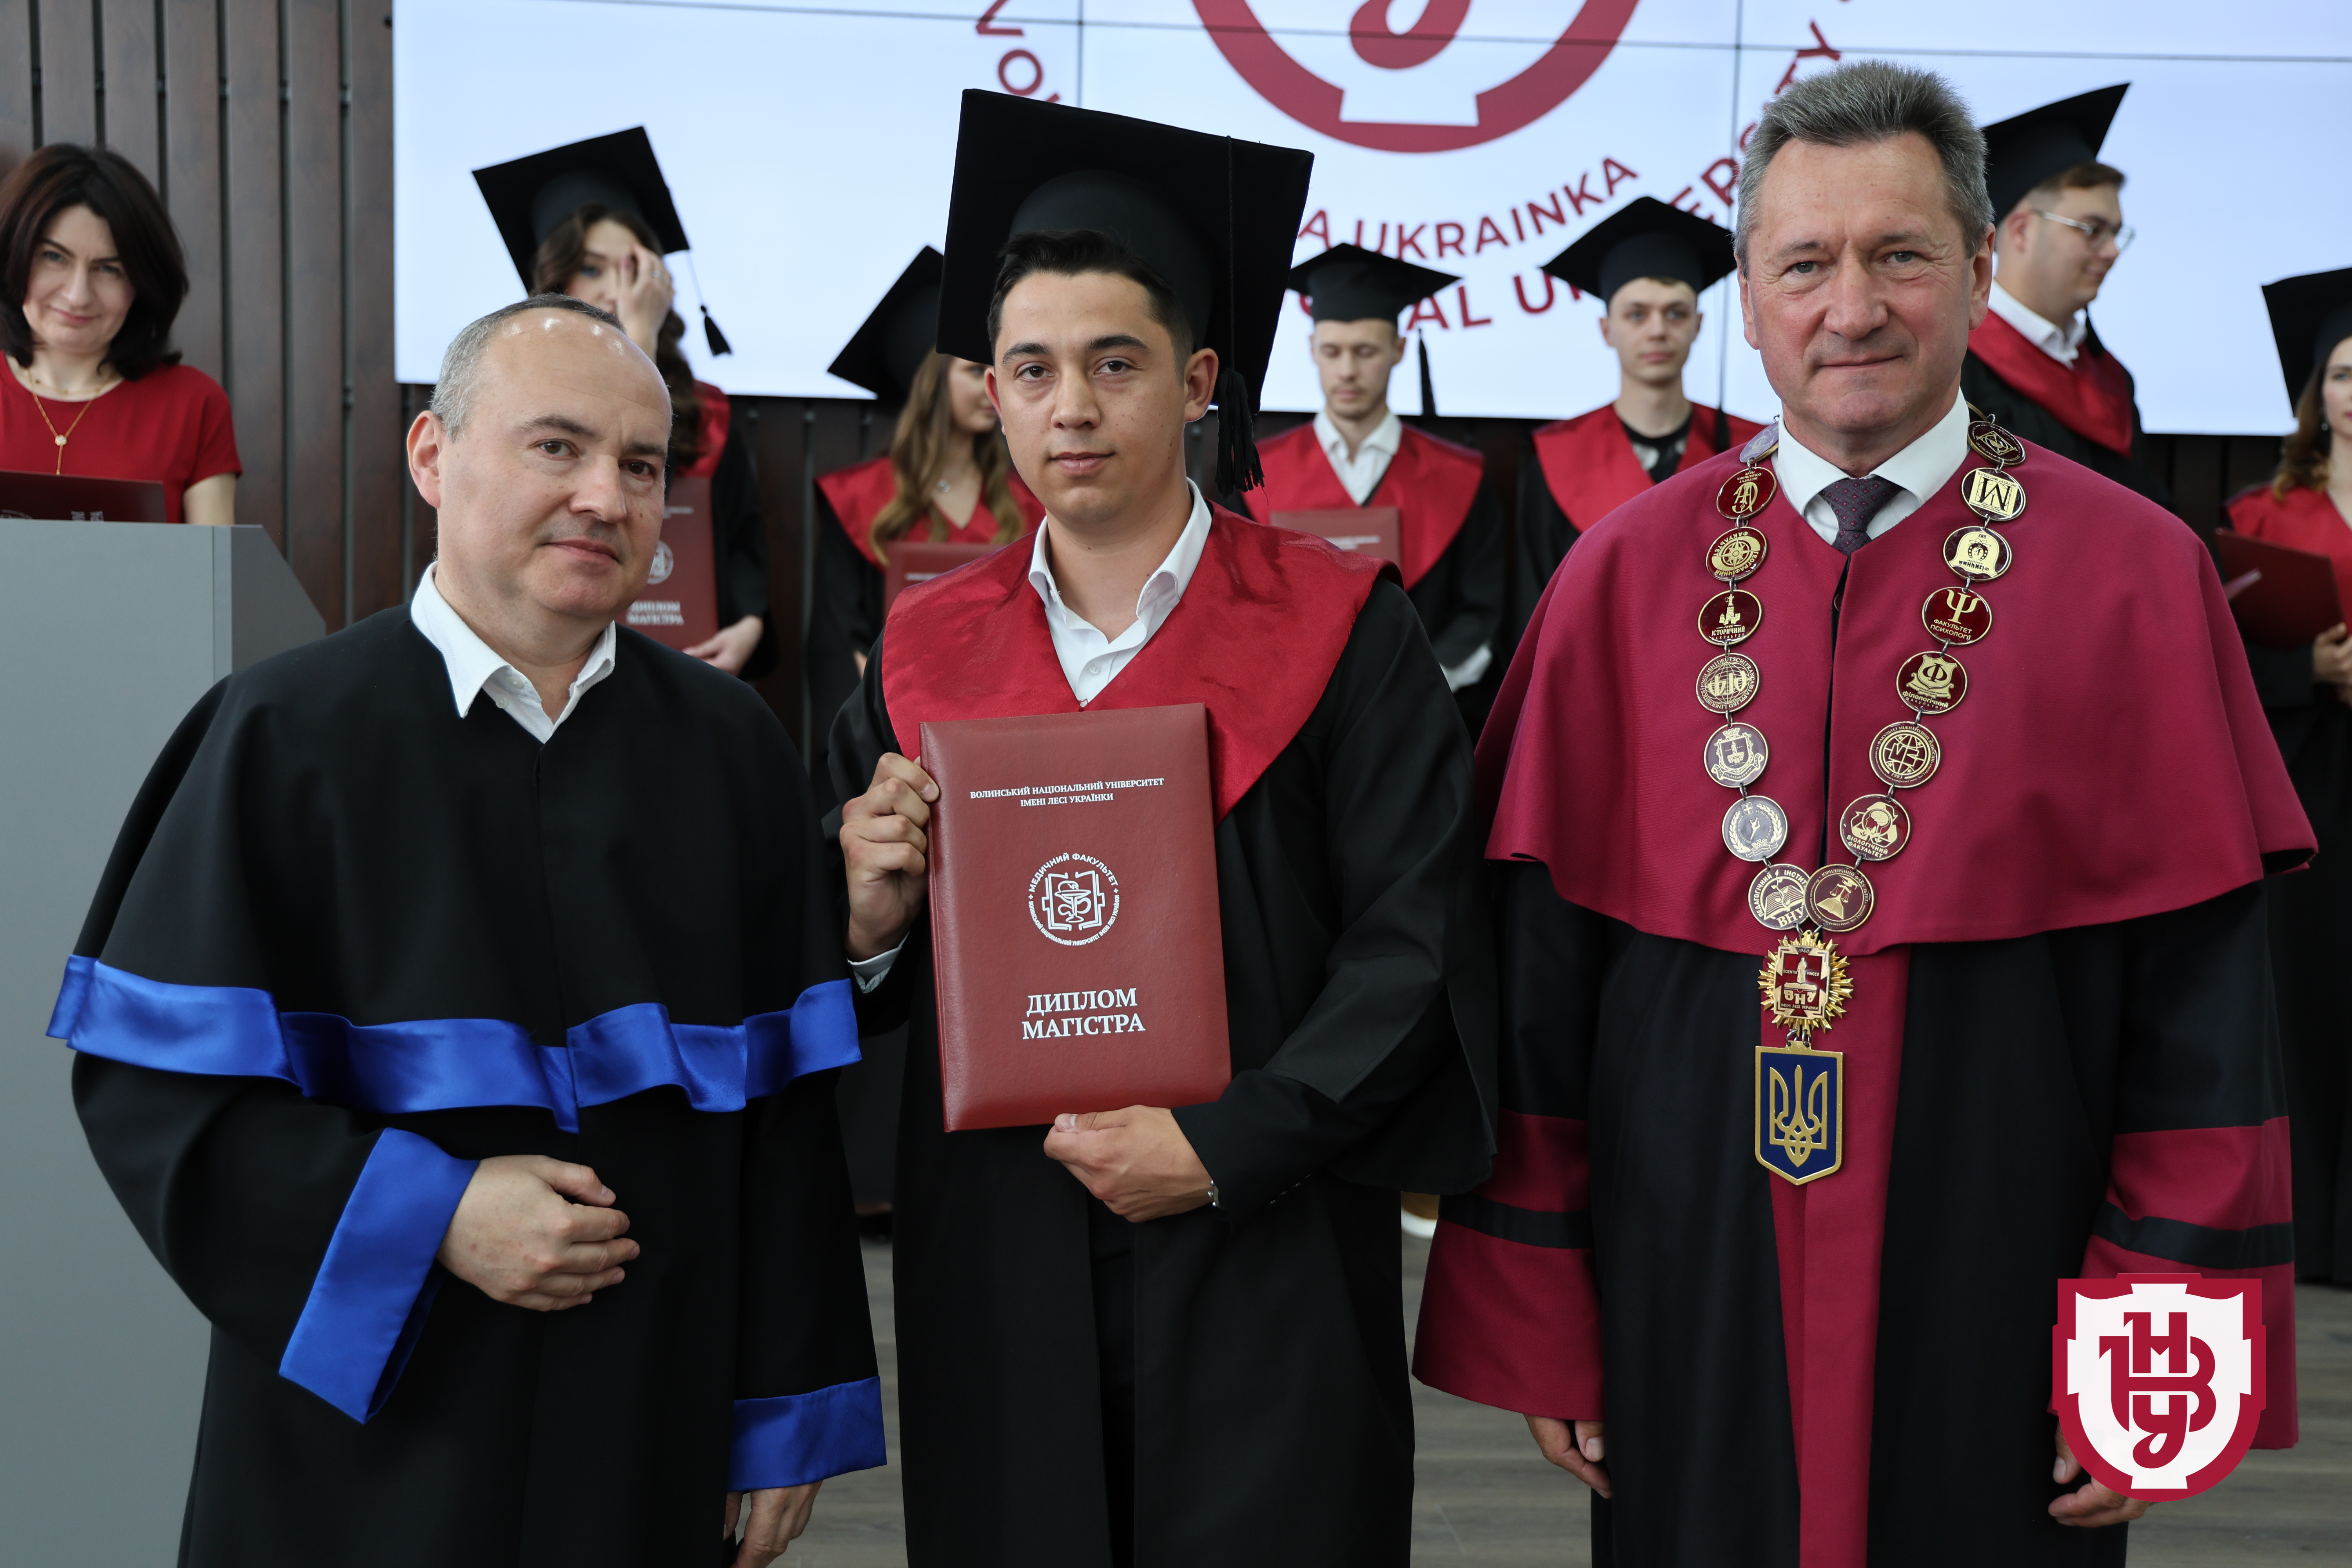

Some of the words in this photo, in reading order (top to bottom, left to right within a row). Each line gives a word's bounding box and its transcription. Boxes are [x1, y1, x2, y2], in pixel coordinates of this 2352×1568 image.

[1354, 156, 1639, 260] UKRAINKA
[1713, 531, 1748, 556] ФАКУЛЬТЕТ
[1714, 551, 1759, 576] ГЕОГРАФІЧНИЙ
[1959, 560, 1989, 572] ФІЗИЧНИЙ
[1711, 626, 1745, 636] ІСТОРИЧНИЙ
[1930, 624, 1971, 641] ПСИХОЛОГІЇ
[1934, 619, 1973, 634] ФАКУЛЬТЕТ
[1717, 657, 1744, 665] DEUTSCH
[1700, 664, 1715, 688] ENGLISH
[1700, 690, 1727, 709] LINGUISTICS
[1729, 693, 1750, 708] APPLIED
[1902, 690, 1949, 708] філологічний
[1878, 727, 1898, 745] ФАКУЛЬТЕТ
[1898, 726, 1929, 740] МІЖНАРОДНИХ
[970, 786, 1031, 799] ВОЛИНСЬКИЙ
[1032, 781, 1104, 795] НАЦІОНАЛЬНИЙ
[1105, 778, 1164, 789] УНІВЕРСИТЕТ
[1020, 798, 1046, 807] ІМЕНІ
[1047, 796, 1068, 806] ЛЕСІ
[1069, 793, 1114, 804] УКРАЇНКИ
[1847, 835, 1888, 855] БІОЛОГІЧНИЙ
[1848, 841, 1883, 858] ФАКУЛЬТЕТ
[1029, 852, 1070, 893] МЕДИЧНИЙ
[1072, 853, 1118, 886] ФАКУЛЬТЕТ
[1753, 872, 1773, 917] ПЕДАГОГІЧНИЙ
[1784, 869, 1808, 887] ІНСТИТ
[1821, 868, 1855, 877] ЮРИДИЧНИЙ
[1855, 875, 1869, 902] ФАКУЛЬТЕТ
[1029, 901, 1044, 929] ВОЛИНСЬКИЙ
[1040, 927, 1072, 946] НАЦІОНАЛЬНИЙ
[1072, 933, 1100, 946] УНІВЕРСИТЕТ
[1099, 924, 1111, 936] ІМЕНІ
[1107, 915, 1116, 927] ЛЕСІ
[1777, 906, 1804, 928] ВНУ
[1026, 988, 1138, 1017] ДИПЛОМ
[1784, 989, 1817, 1005] ВНУ
[1022, 1013, 1146, 1039] МАГІСТРА
